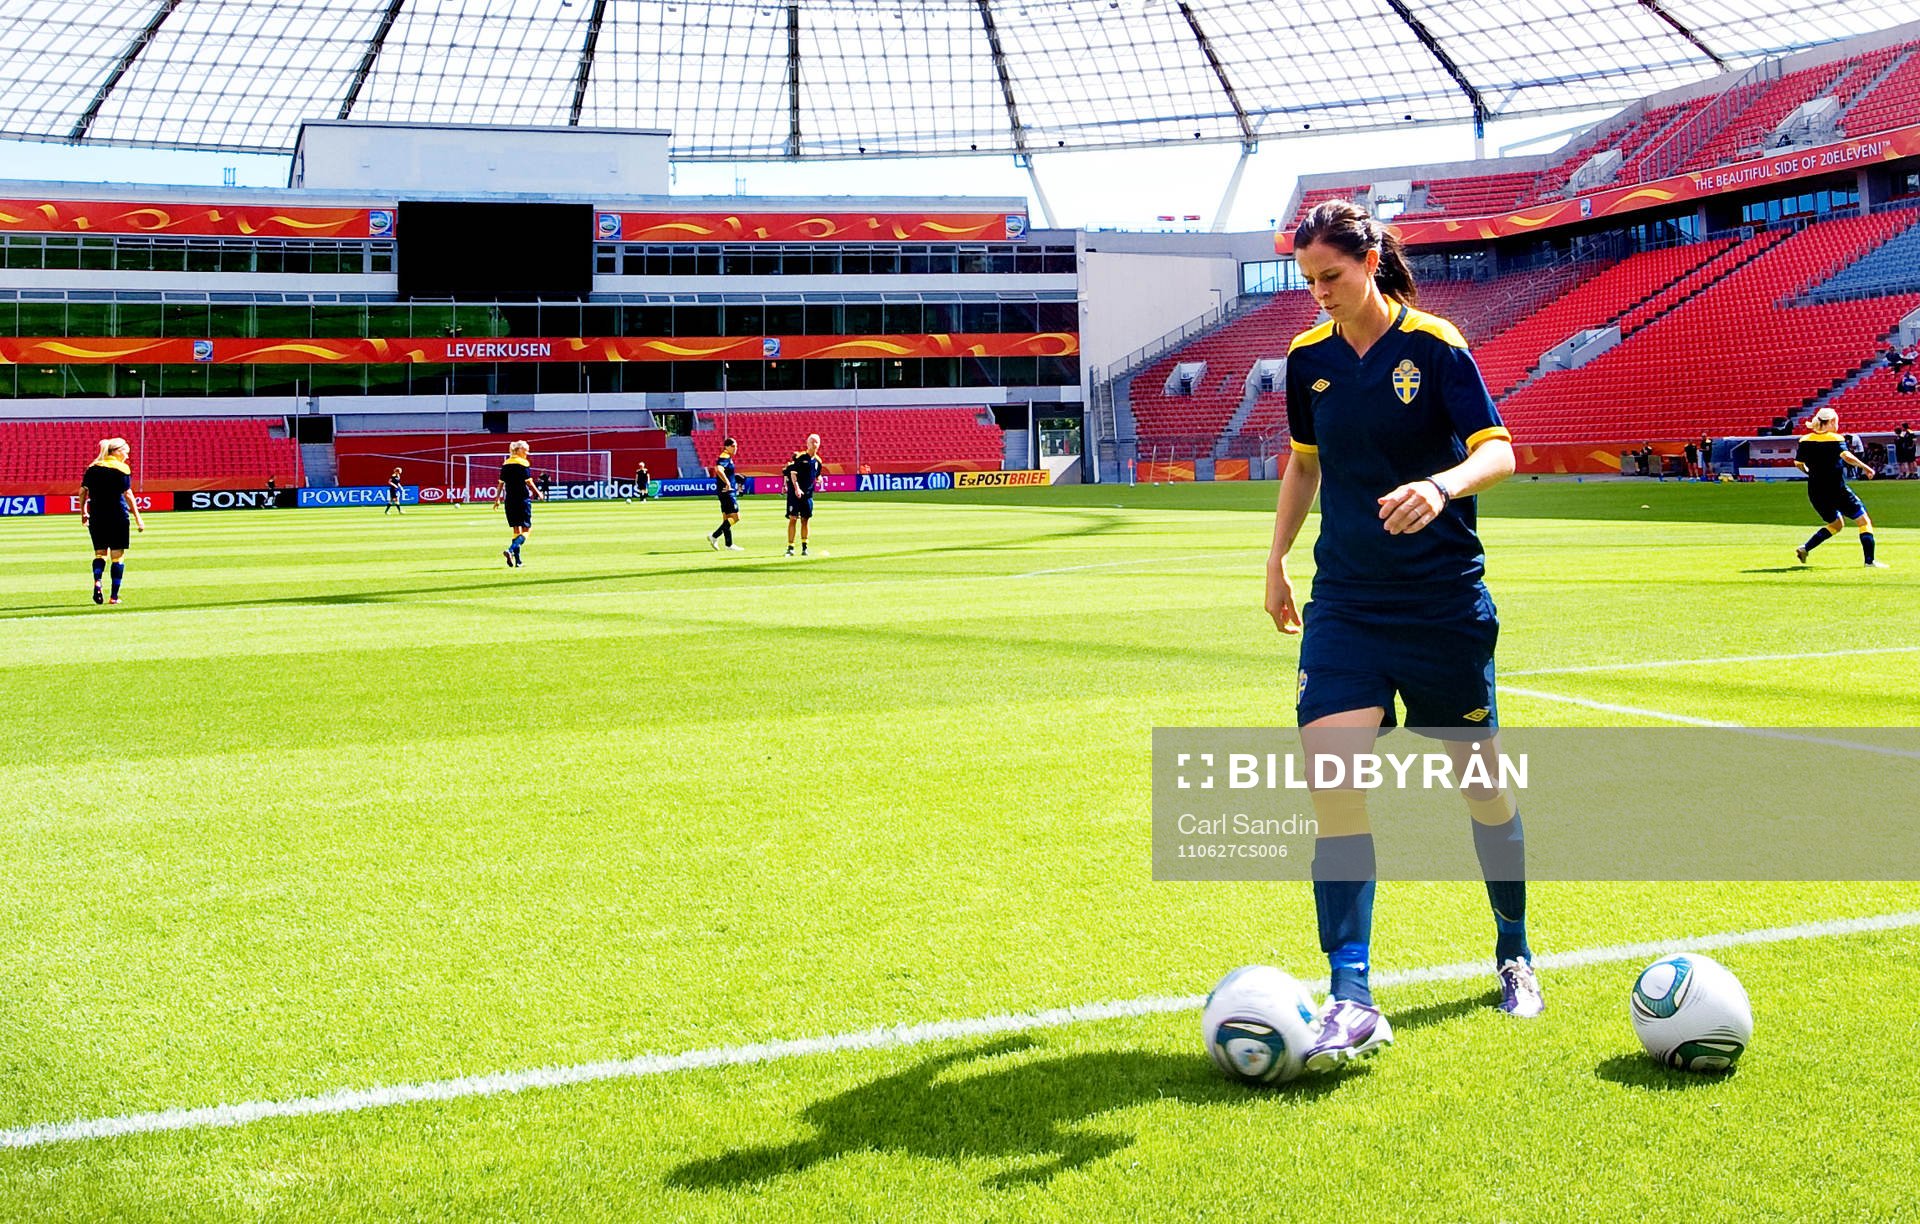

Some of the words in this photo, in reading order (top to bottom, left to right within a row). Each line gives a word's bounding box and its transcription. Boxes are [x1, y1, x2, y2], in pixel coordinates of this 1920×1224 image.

[1694, 177, 1713, 191] THE
[1716, 165, 1772, 187] BEAUTIFUL
[1774, 160, 1799, 175] SIDE
[1801, 156, 1817, 169] OF
[446, 343, 551, 357] LEVERKUSEN
[663, 483, 704, 492] FOOTBALL
[859, 473, 924, 491] Allianz
[302, 489, 411, 504] POWERAE
[422, 490, 442, 499] KIA
